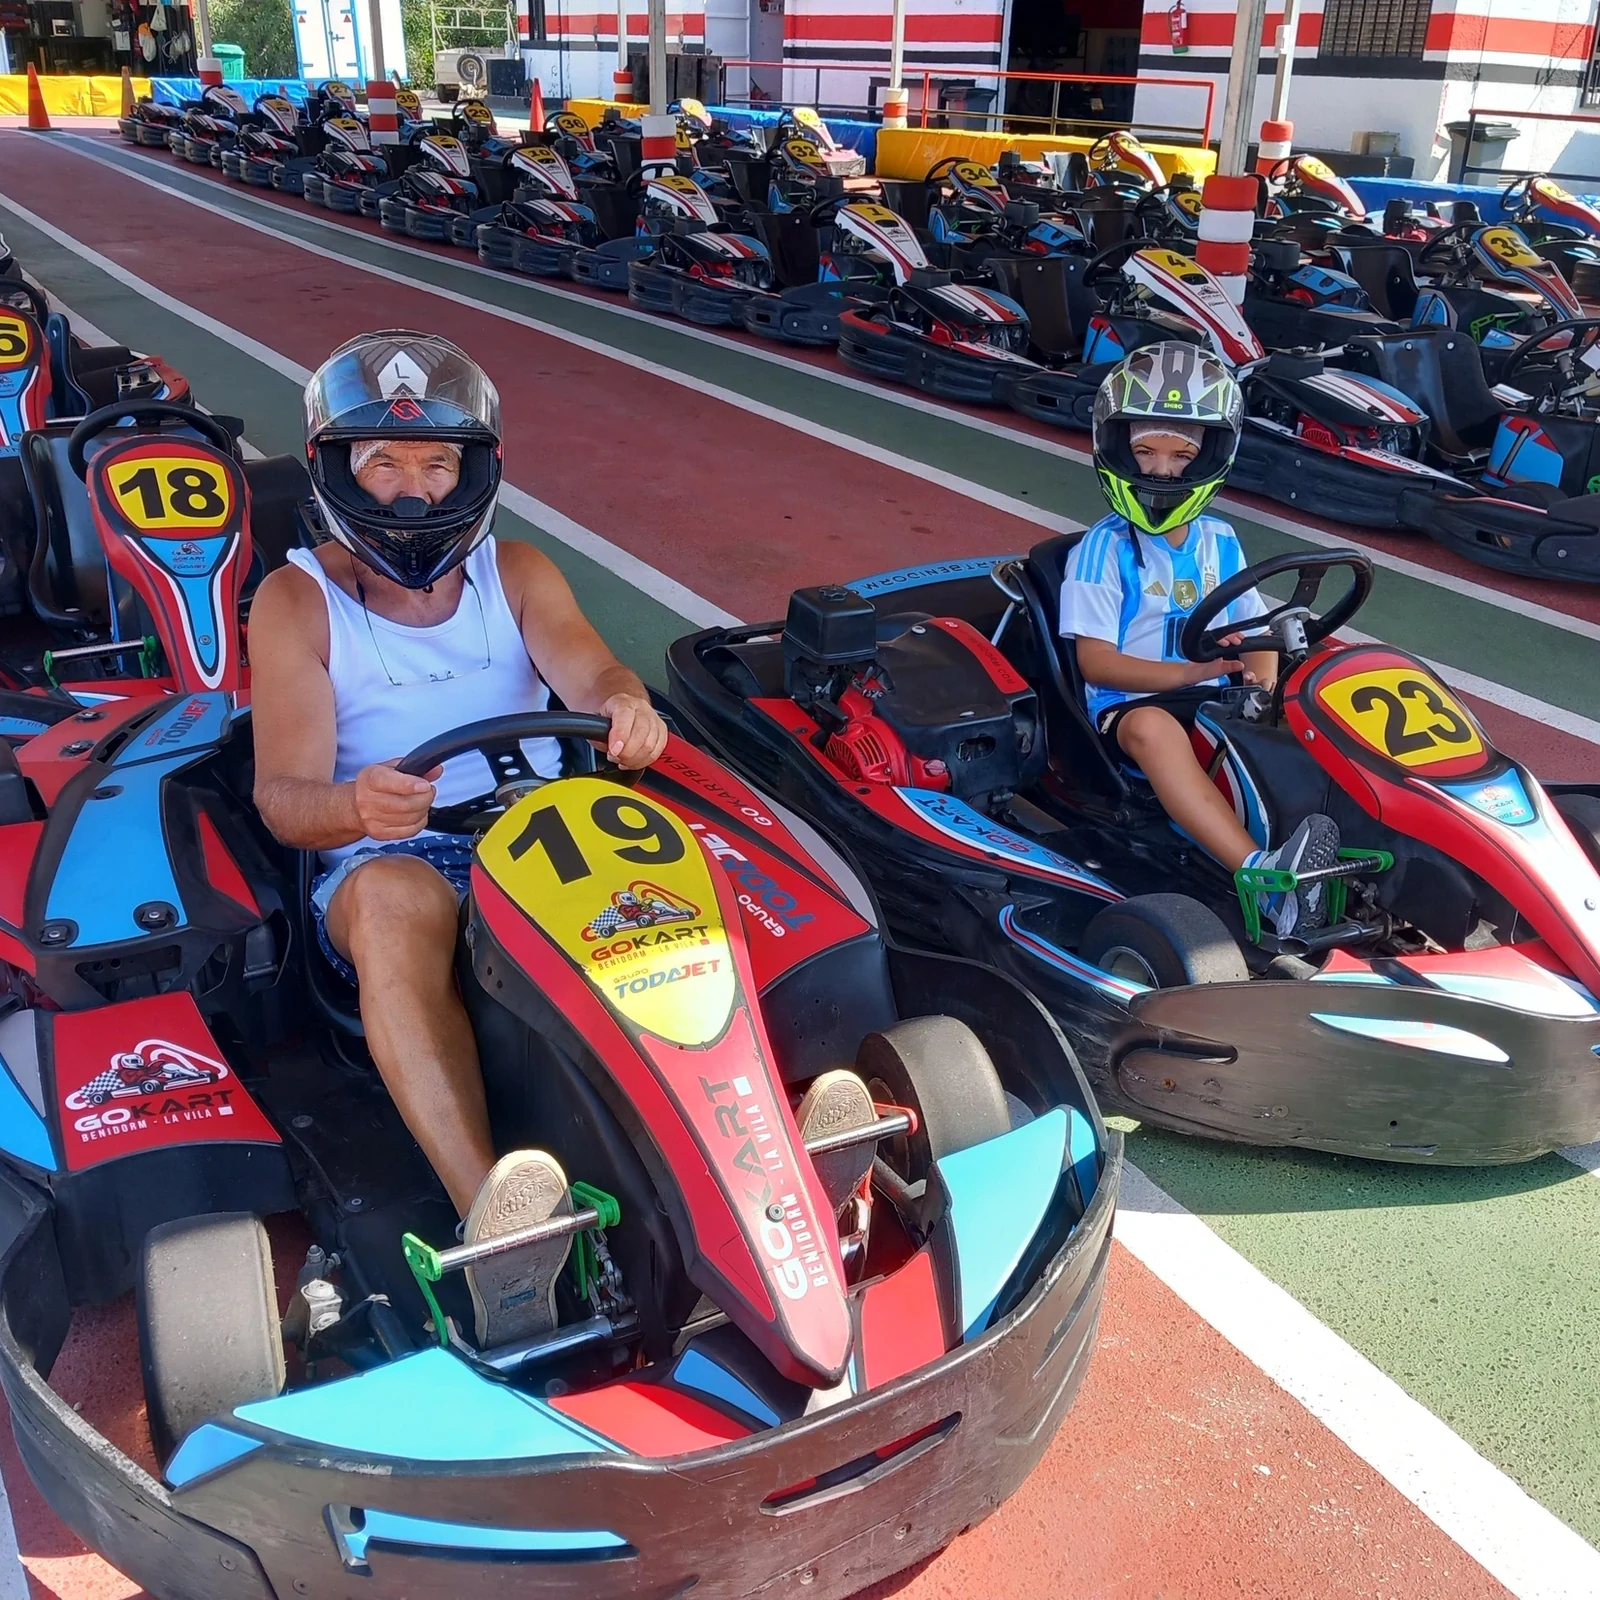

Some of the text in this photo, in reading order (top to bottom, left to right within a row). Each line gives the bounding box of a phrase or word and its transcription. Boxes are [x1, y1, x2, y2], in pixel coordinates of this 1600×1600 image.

[468, 108, 490, 119] 29
[561, 119, 585, 130] 36
[790, 144, 819, 158] 32
[672, 178, 685, 186] 5
[960, 167, 993, 181] 34
[866, 206, 884, 216] 1
[1166, 254, 1187, 268] 4
[1490, 236, 1534, 258] 35
[1163, 402, 1184, 410] SHIRO
[118, 467, 226, 519] 18
[158, 698, 212, 746] TODAJET
[1350, 680, 1472, 758] 23
[660, 753, 773, 826] GOKARTBEN
[507, 794, 686, 886] 19
[915, 798, 1030, 853] GOKART
[738, 894, 786, 938] GRUPO
[591, 925, 708, 961] GOKART
[598, 950, 647, 971] BENIDORM
[659, 944, 670, 953] LA
[675, 940, 695, 949] VILA
[613, 968, 649, 983] GRUPO
[614, 959, 720, 999] TODAJET
[73, 1089, 234, 1132] GOKART
[81, 1120, 148, 1143] BENIDORM
[164, 1114, 179, 1125] LA
[184, 1109, 212, 1122] VILA
[745, 1103, 772, 1144] VILA
[763, 1149, 784, 1172] LA
[698, 1075, 808, 1300] GOKART
[780, 1193, 828, 1288] BENIDORM
